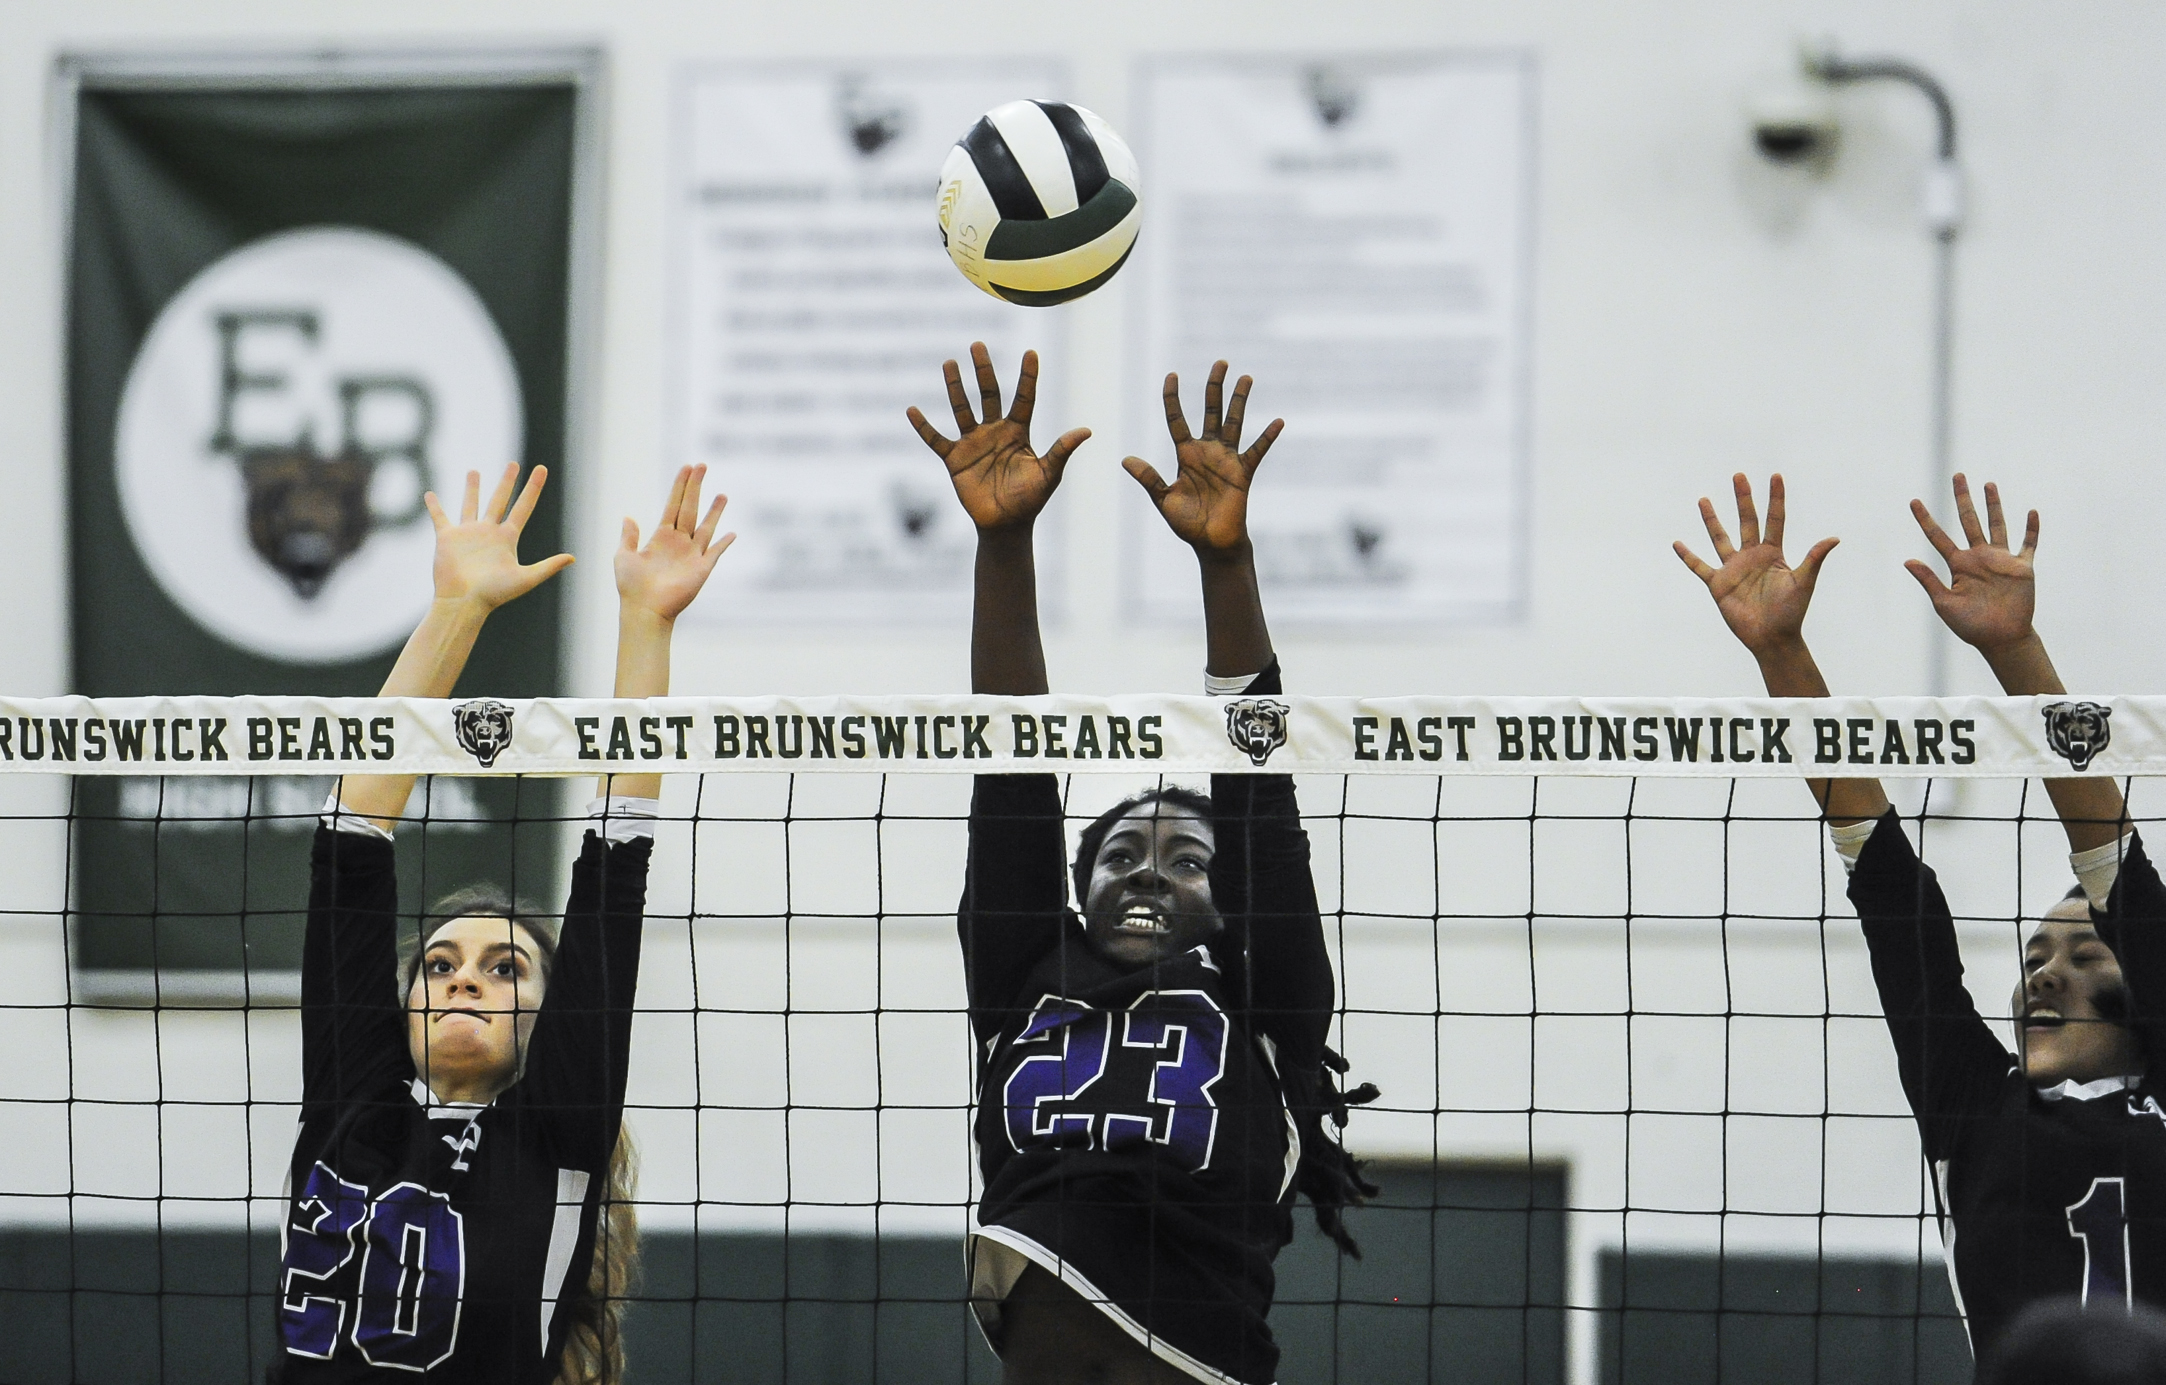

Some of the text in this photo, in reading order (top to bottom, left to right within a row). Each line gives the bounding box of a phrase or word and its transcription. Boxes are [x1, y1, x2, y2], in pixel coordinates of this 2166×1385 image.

[247, 716, 395, 761] BEARS
[574, 713, 1164, 760] EAST BRUNSWICK BEARS
[1352, 715, 1977, 765] EAST BRUNSWICK BEARS
[1003, 989, 1230, 1174] 23
[280, 1160, 466, 1373] 20
